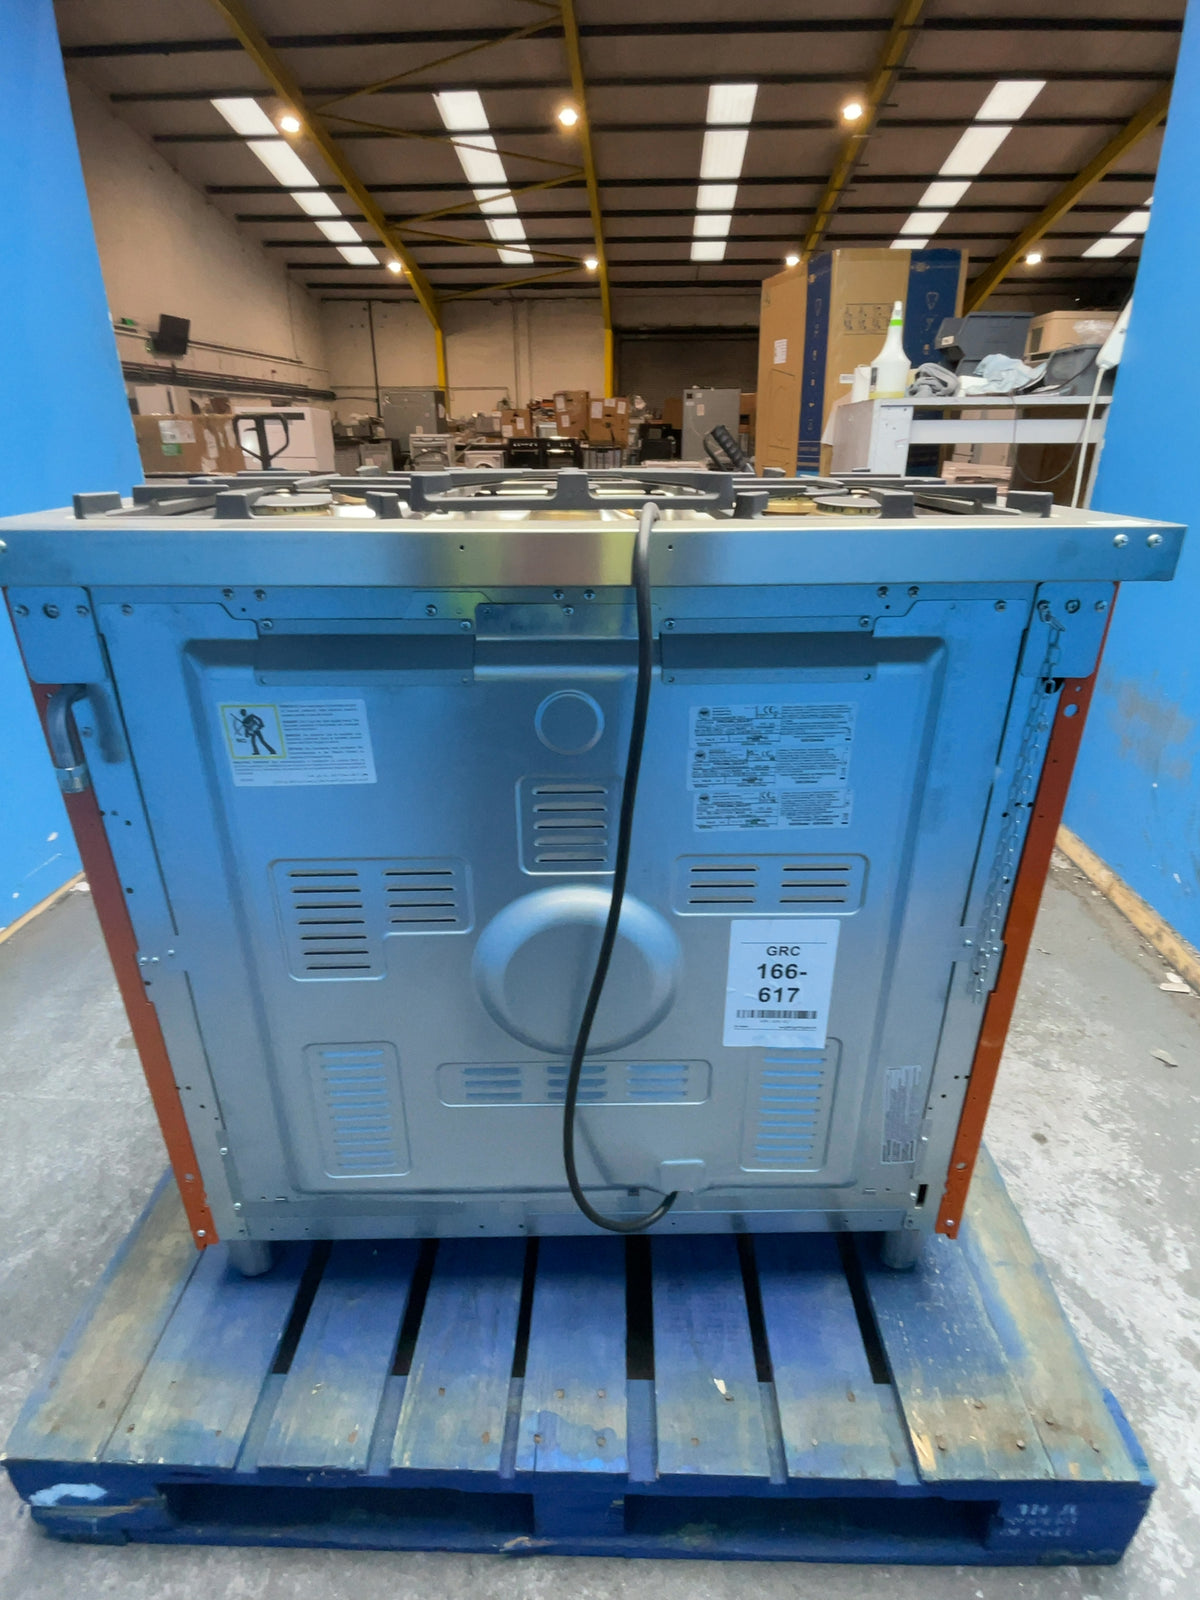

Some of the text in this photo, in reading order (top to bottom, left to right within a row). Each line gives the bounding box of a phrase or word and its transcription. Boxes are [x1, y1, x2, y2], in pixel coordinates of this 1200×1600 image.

[766, 945, 801, 956] GRC
[757, 963, 808, 979] 166-
[758, 987, 800, 1003] 617
